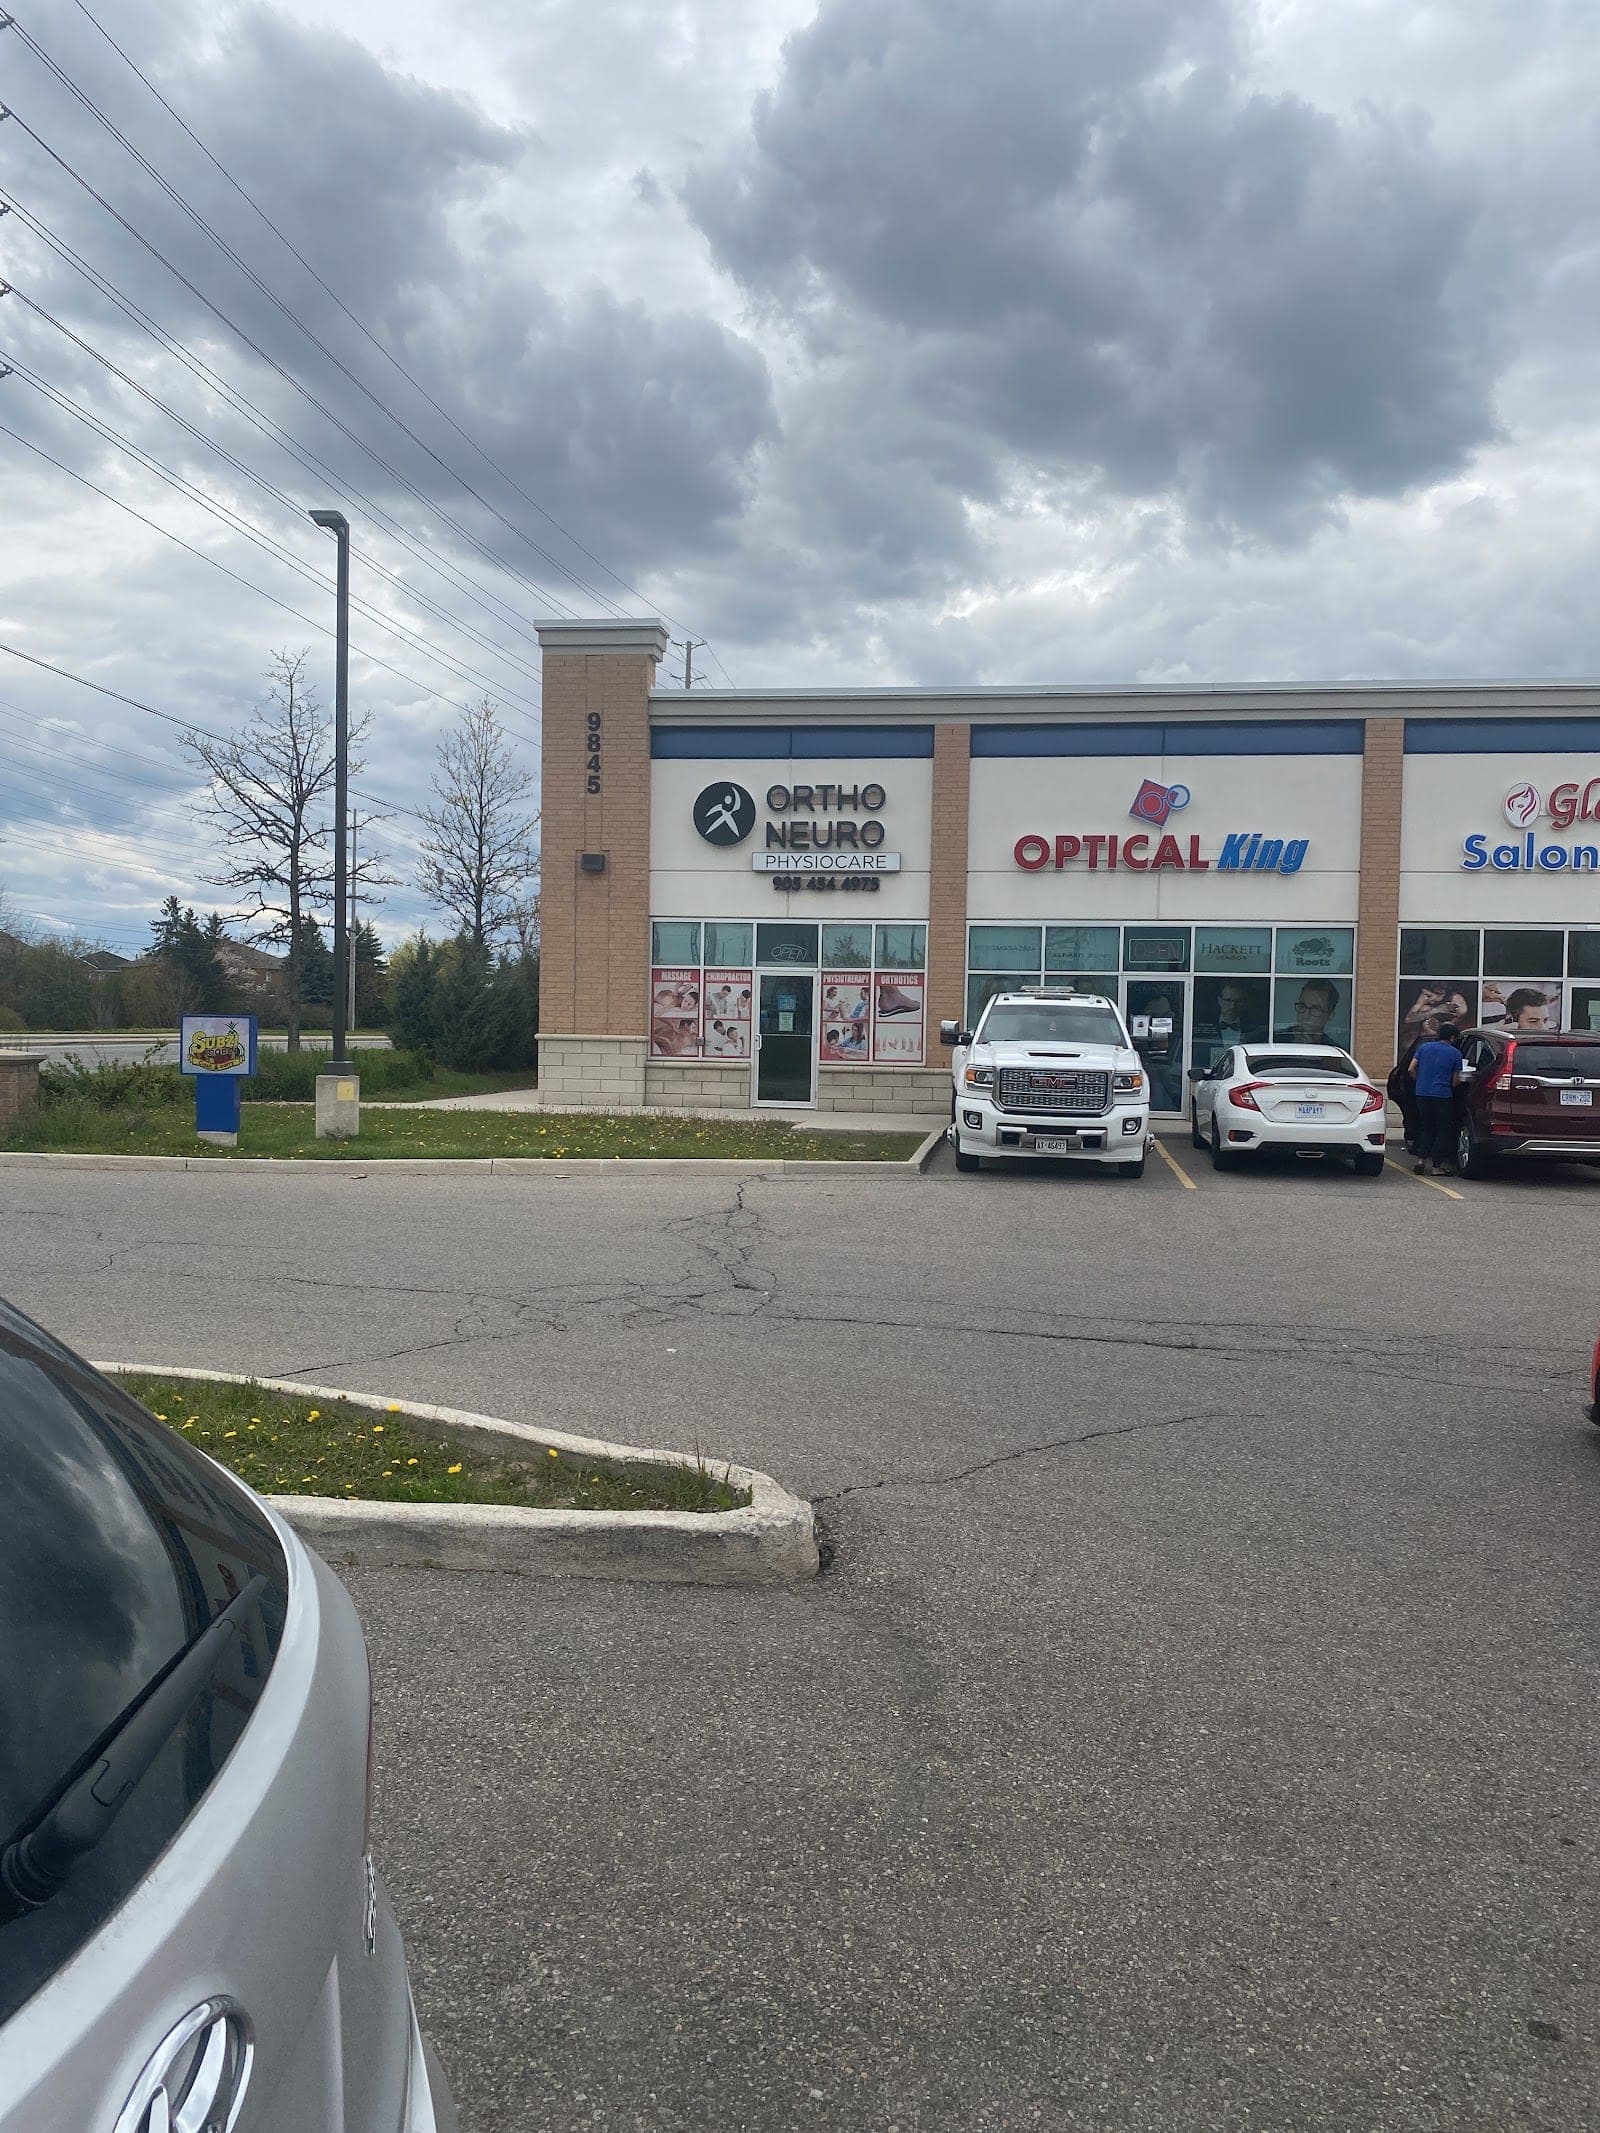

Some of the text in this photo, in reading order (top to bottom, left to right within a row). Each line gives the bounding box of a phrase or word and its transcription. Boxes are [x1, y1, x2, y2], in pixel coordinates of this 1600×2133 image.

[587, 711, 601, 794] 9845
[766, 783, 886, 811] ORTHO
[766, 820, 885, 848] NEURO
[1013, 833, 1310, 874] OPTICAL King
[1461, 832, 1600, 870] Salon
[765, 855, 887, 869] PHYSIOCARE
[773, 876, 801, 891] 905
[771, 945, 809, 961] OPEN
[1133, 941, 1181, 960] OPEN
[1201, 943, 1263, 954] HACKETT
[1296, 957, 1331, 966] Roots
[661, 971, 692, 981] MASSAGE
[823, 974, 869, 984] PHYSIOTHERAPY
[880, 975, 919, 985] ORTHOTICS
[1031, 1077, 1076, 1088] GMC
